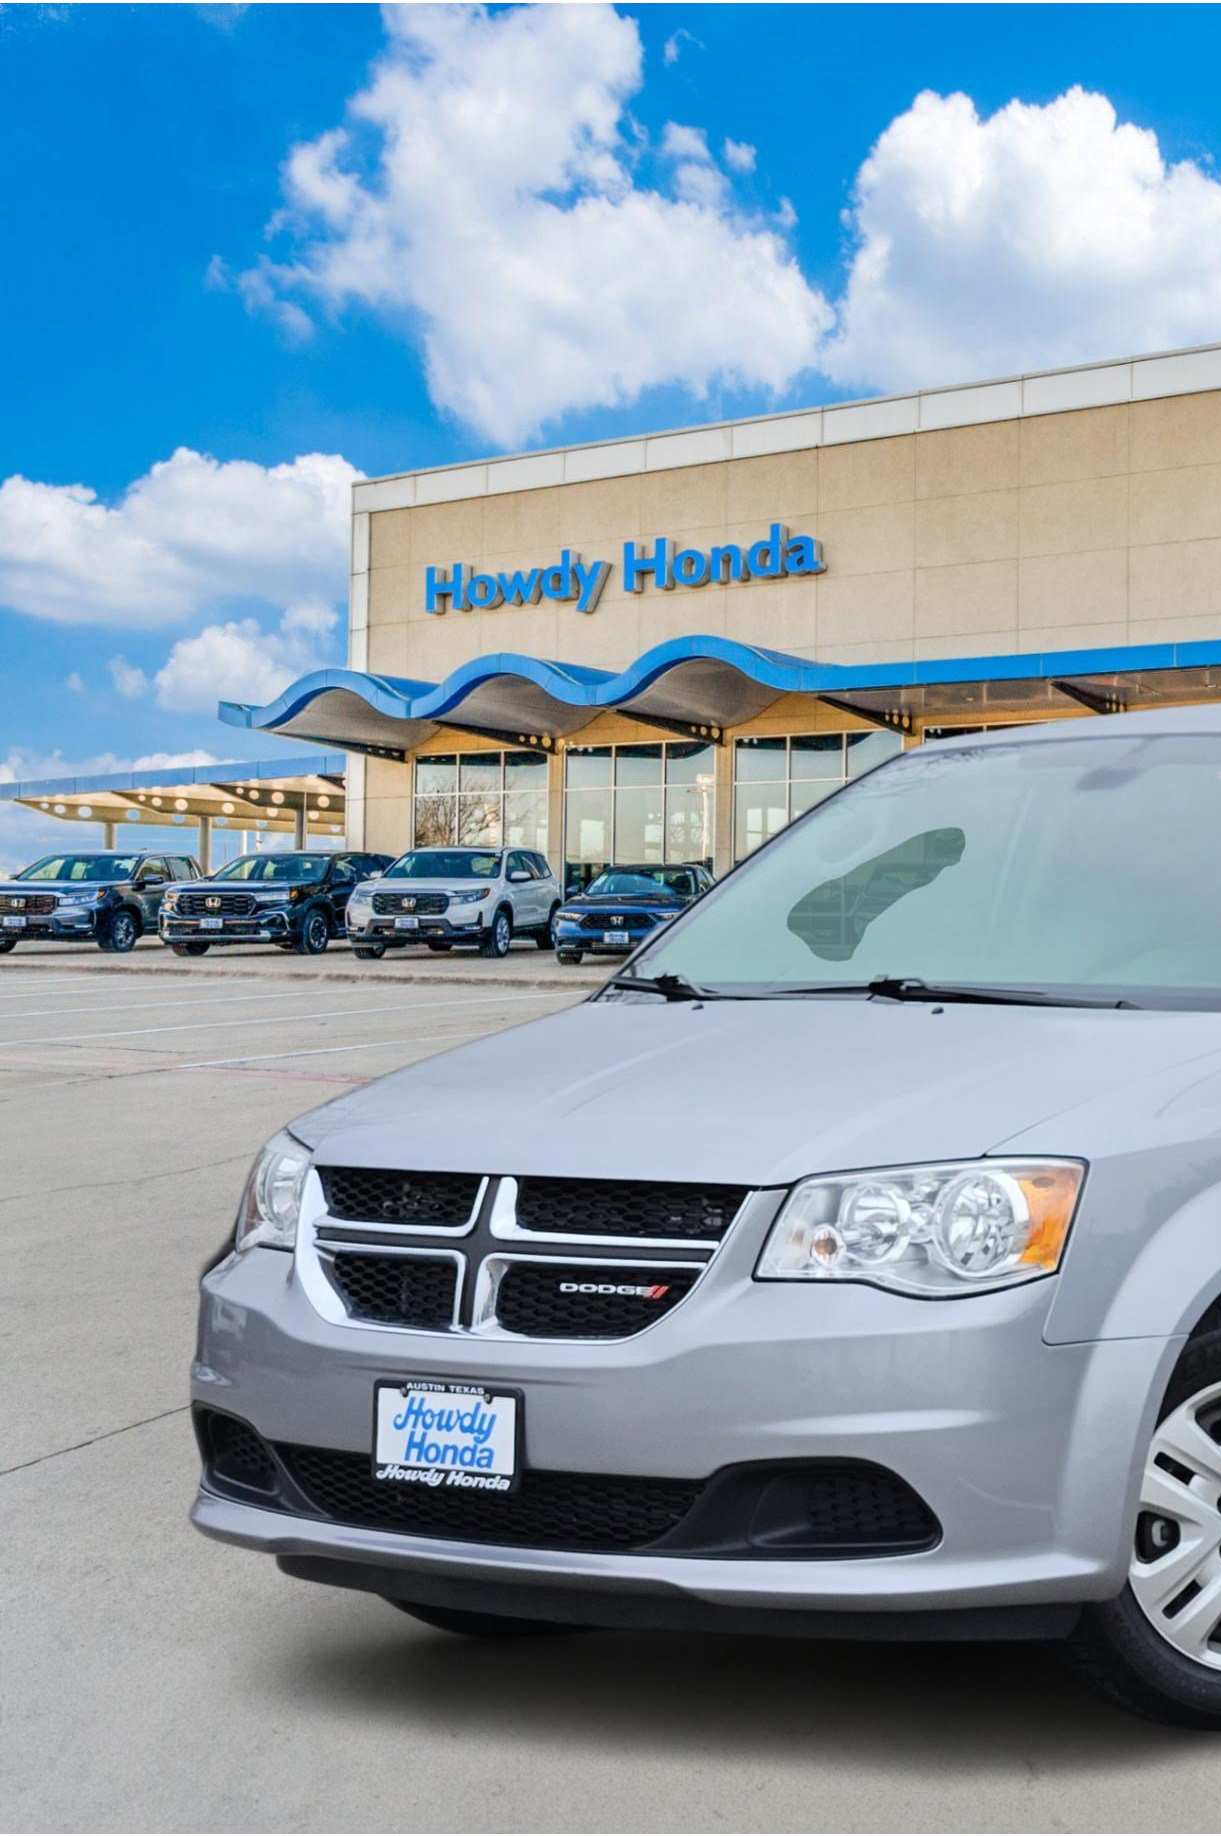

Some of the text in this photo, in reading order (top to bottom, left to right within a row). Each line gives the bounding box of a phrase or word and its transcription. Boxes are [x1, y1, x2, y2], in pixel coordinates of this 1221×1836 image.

[424, 522, 827, 616] Howdy Honda
[559, 1282, 653, 1298] DODGE
[406, 1382, 485, 1395] AUSTIN TEXAS
[393, 1396, 497, 1444] Howdy
[404, 1430, 495, 1469] Honda
[376, 1464, 511, 1491] Howdy Honda
